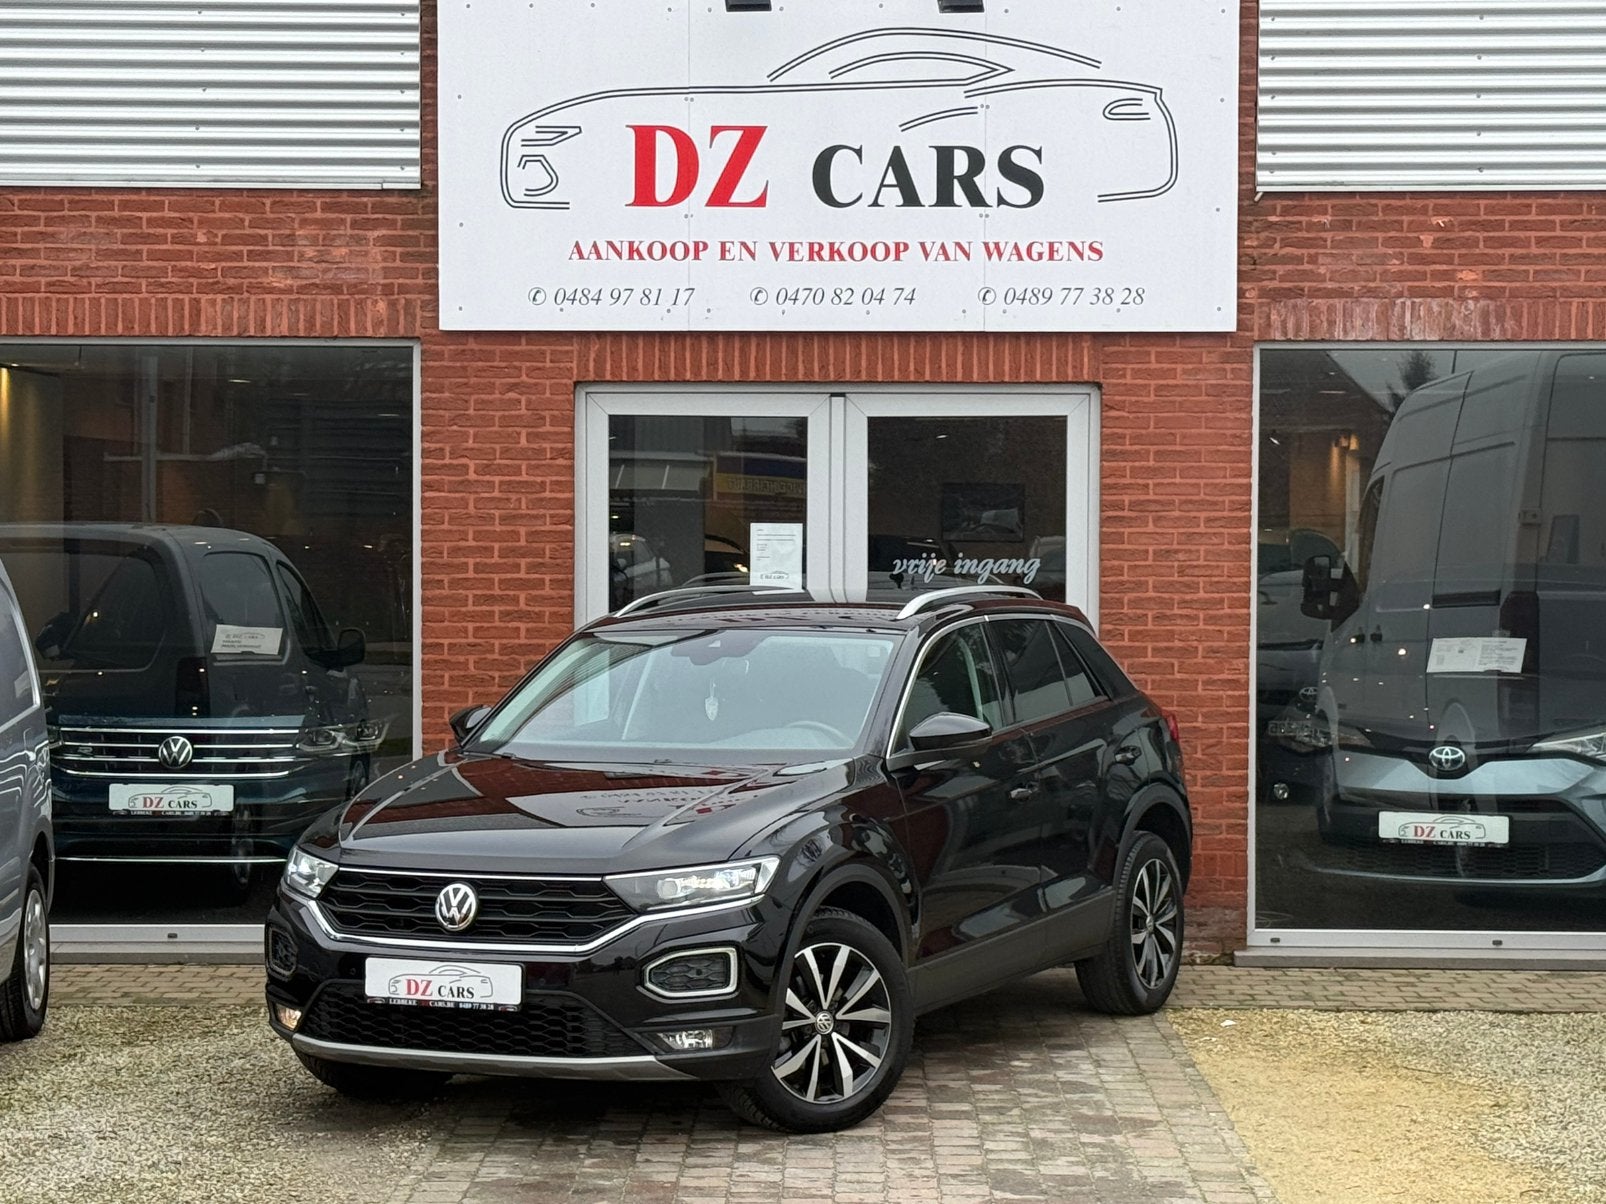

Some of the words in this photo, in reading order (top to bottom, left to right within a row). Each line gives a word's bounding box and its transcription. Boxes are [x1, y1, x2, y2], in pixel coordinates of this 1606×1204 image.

[625, 125, 768, 208] DZ
[811, 144, 1045, 209] CARS
[568, 240, 709, 262] AANKOOP
[718, 240, 759, 262] EN
[768, 241, 910, 262] VERKOOP
[918, 241, 972, 262] VAN
[982, 241, 1104, 262] WAGENS
[554, 287, 602, 306] 0484
[609, 287, 635, 306] 97
[639, 287, 663, 306] 81
[669, 287, 695, 306] 17
[776, 287, 826, 306] 0470
[830, 287, 855, 306] 82
[861, 287, 886, 306] 04
[892, 287, 917, 306] 74
[1003, 287, 1053, 306] 0489
[1060, 287, 1085, 306] 77
[1090, 287, 1115, 306] 38
[1120, 287, 1146, 306] 28
[892, 552, 947, 584] vrije
[953, 552, 1041, 585] ingang
[143, 796, 165, 809] DZ
[168, 800, 198, 809] CARS
[1413, 825, 1436, 838] DZ
[1439, 829, 1472, 840] CARS
[405, 978, 433, 997] DZ
[437, 985, 475, 999] CARS
